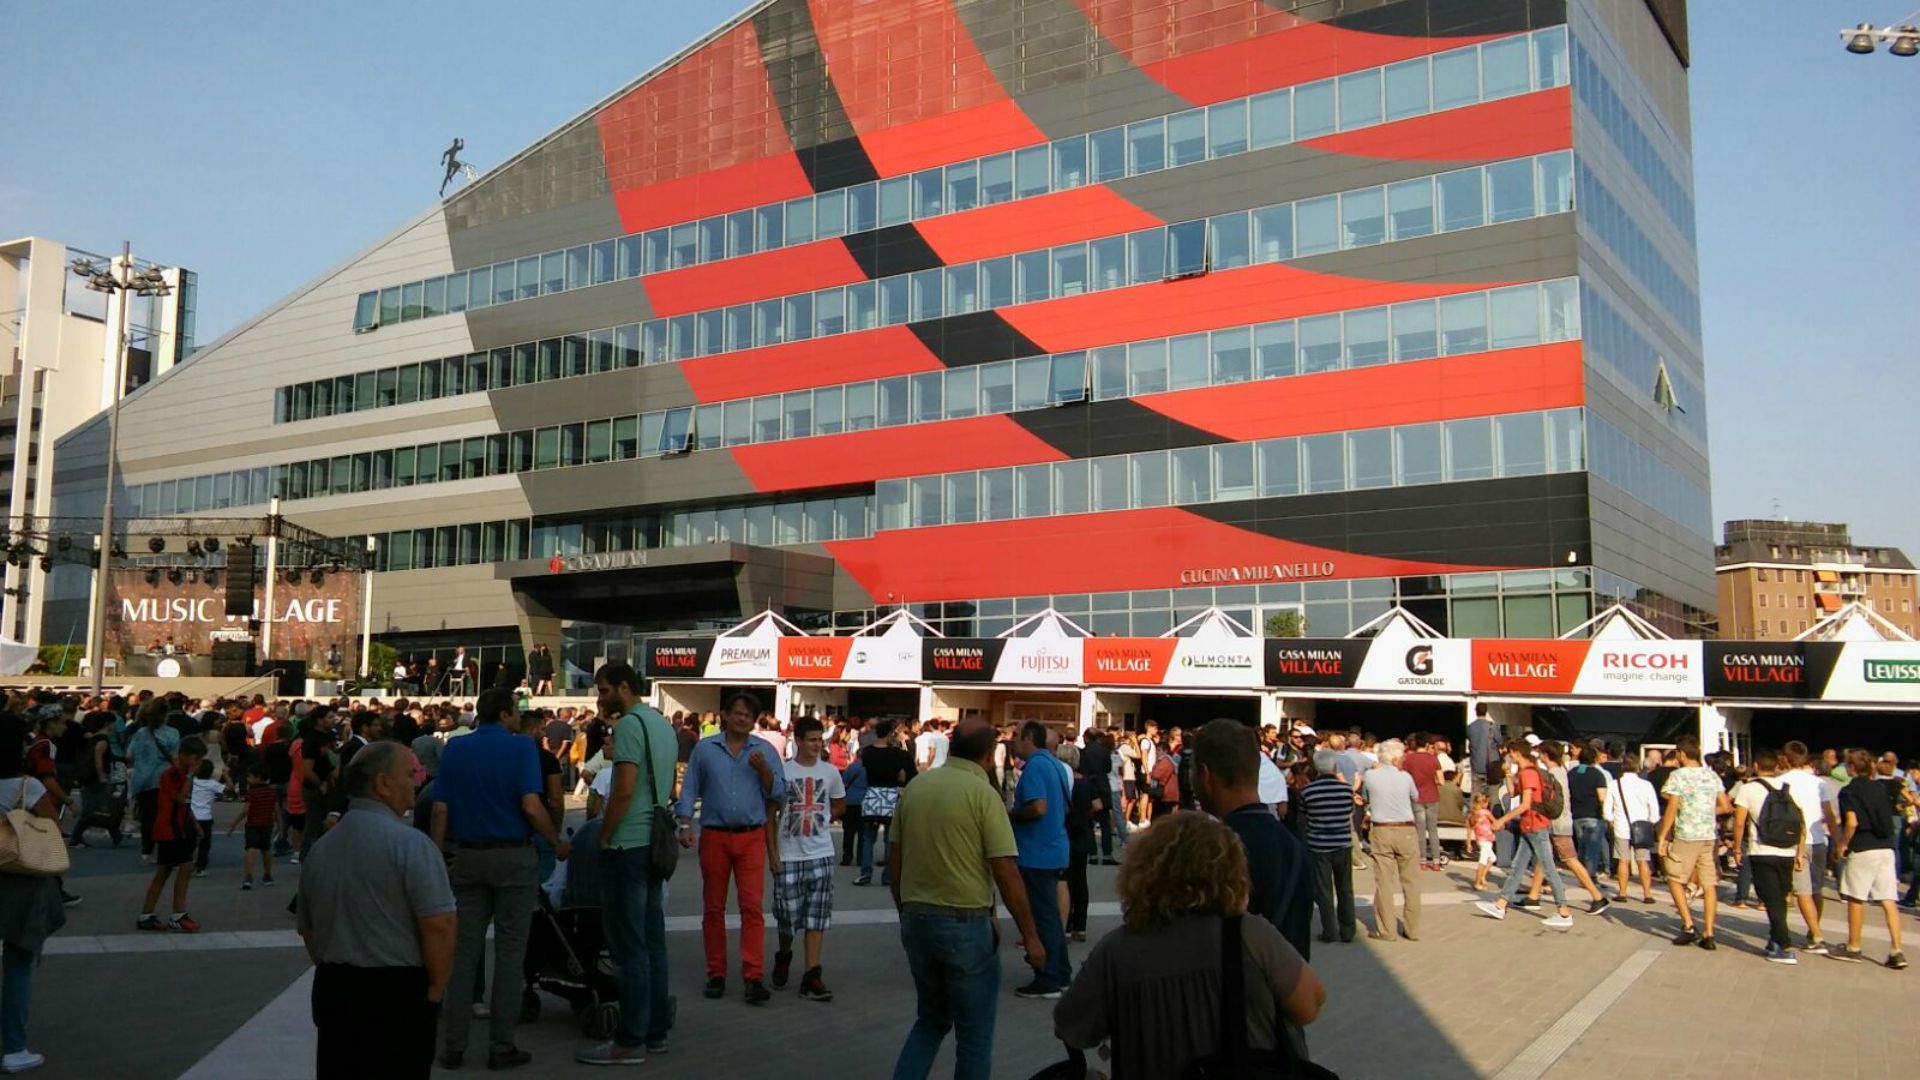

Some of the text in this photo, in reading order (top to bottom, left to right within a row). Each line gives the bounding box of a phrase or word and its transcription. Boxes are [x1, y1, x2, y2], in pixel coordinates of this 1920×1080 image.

[1180, 561, 1335, 583] CUCINA MILANELLO
[121, 597, 215, 622] MUSIC
[655, 647, 697, 655] CASA MILAN
[720, 648, 771, 660] PREMIUM
[933, 647, 983, 657] CASA MILAN
[1279, 649, 1342, 660] CASA MILAN
[655, 655, 697, 667] VILLAGE
[788, 655, 833, 667] VILLAGE
[933, 657, 983, 670] VILLAGE
[1020, 655, 1069, 672] FUJITSU
[1096, 658, 1152, 671] VILLAGE
[1193, 655, 1252, 664] LIMONTA
[1602, 653, 1689, 669] RICOH
[1722, 653, 1805, 666] CASA MILAN
[1279, 660, 1342, 674] VILLAGE
[1487, 662, 1559, 678] VILLAGE
[1602, 671, 1688, 684] imagine change
[1723, 666, 1805, 682] VILLAGE
[1397, 677, 1445, 685] GATORADE
